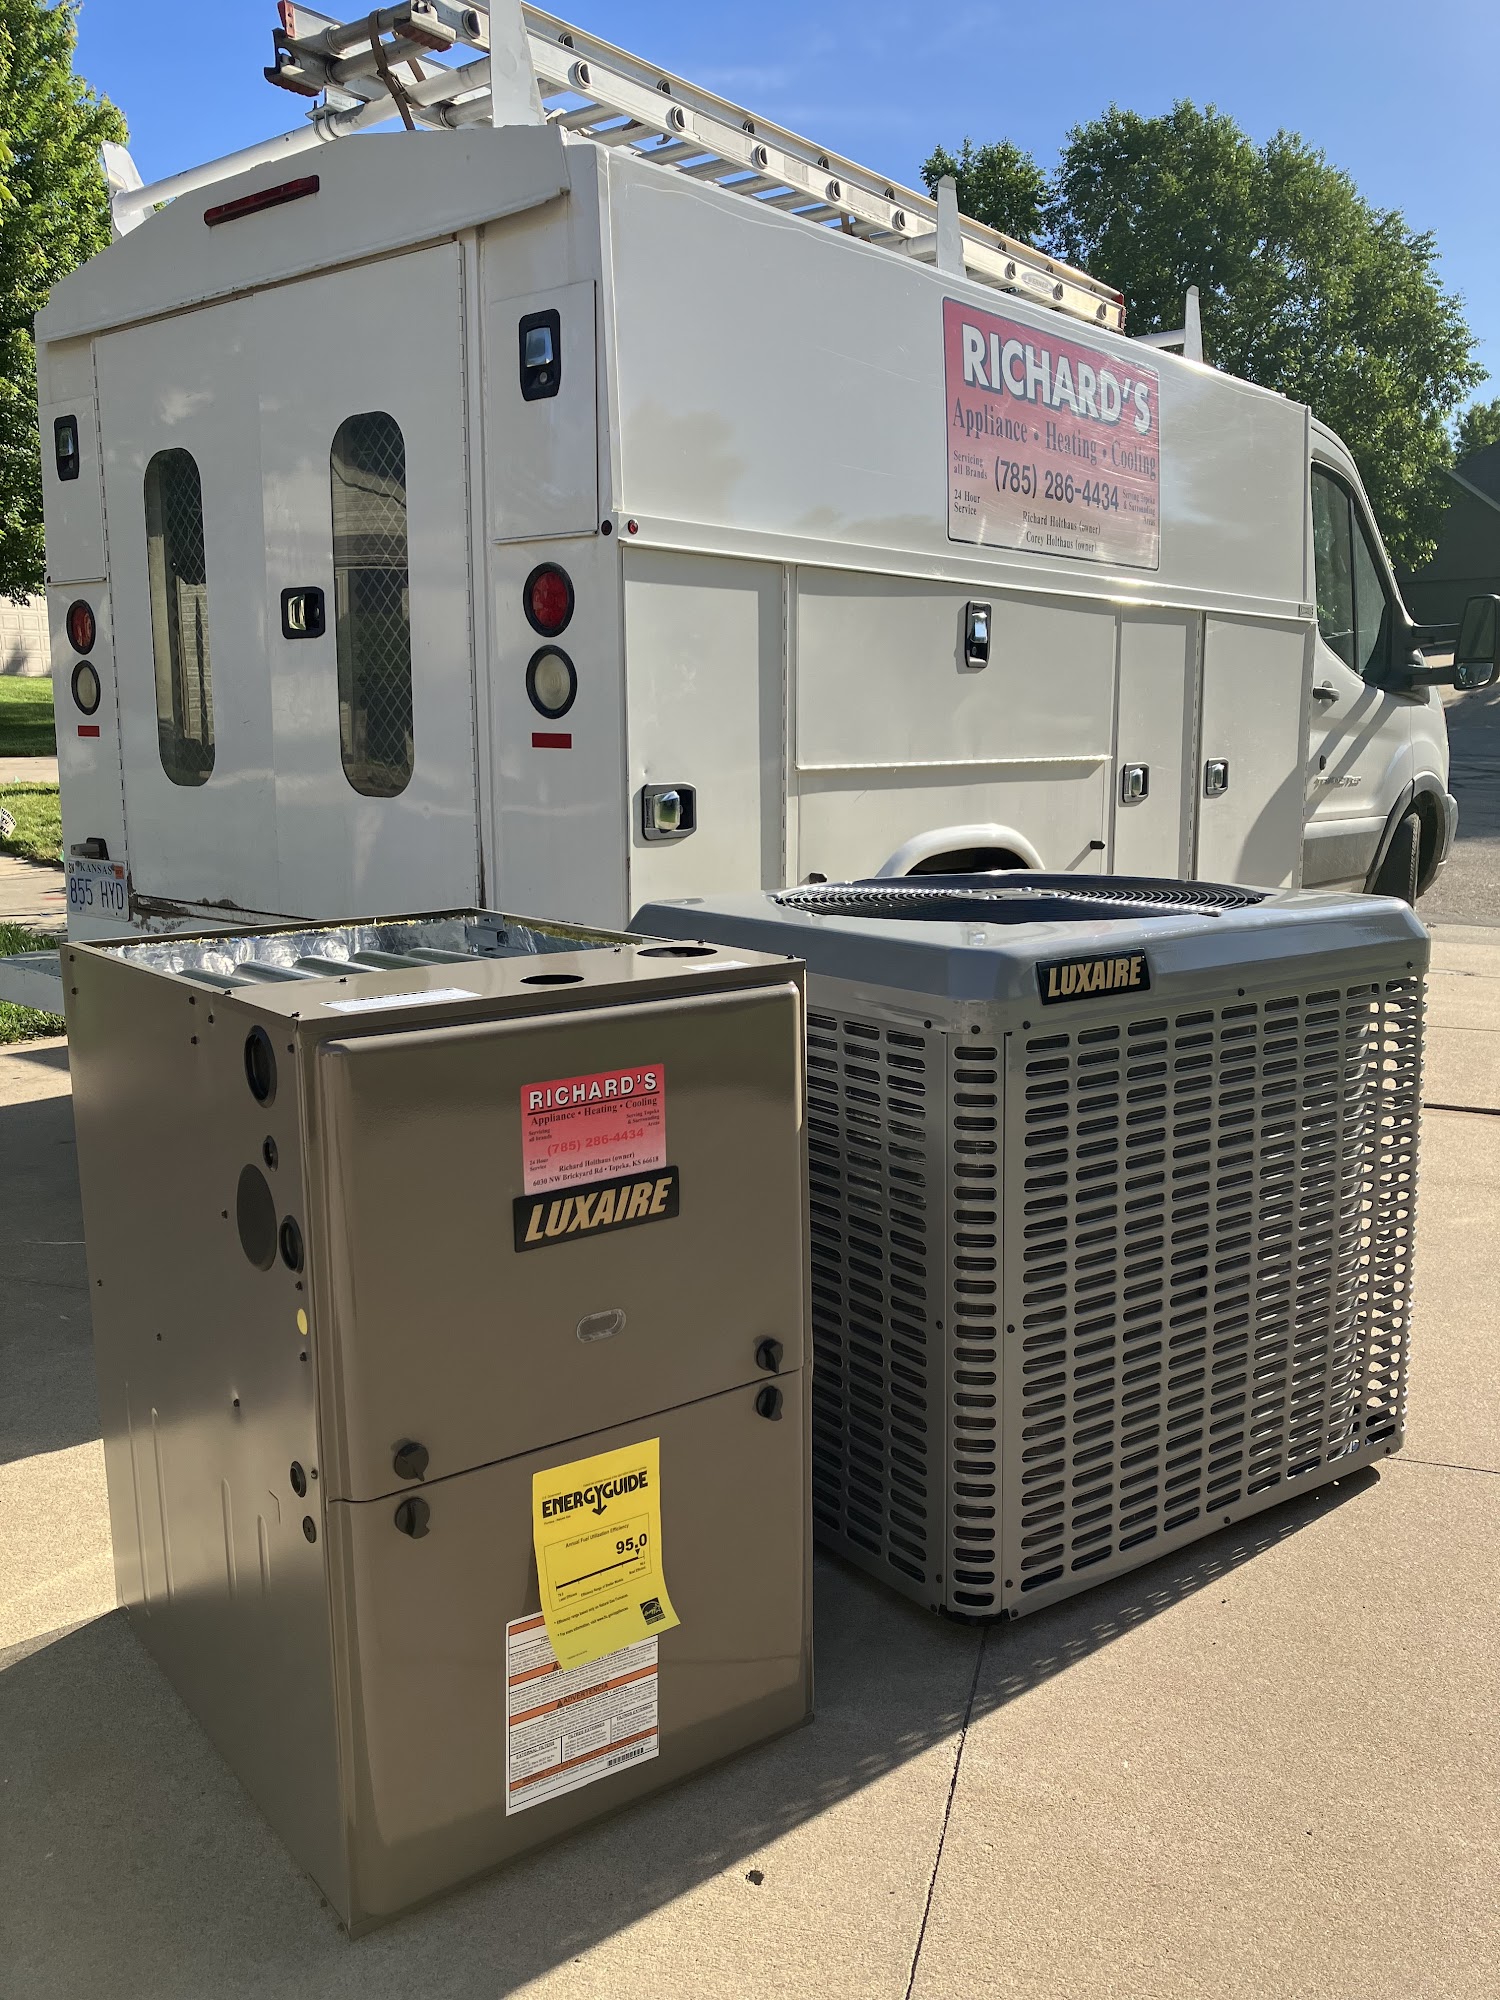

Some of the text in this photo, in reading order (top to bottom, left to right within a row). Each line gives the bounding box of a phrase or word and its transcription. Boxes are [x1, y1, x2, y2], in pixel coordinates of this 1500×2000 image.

[962, 322, 1152, 436] RICHARD'S
[953, 397, 1156, 480] Appliance Heating Cooling
[953, 450, 984, 468] Servicing
[954, 464, 987, 480] all Brands
[995, 456, 1119, 512] (785) 286-4434
[954, 489, 980, 504] 24 Hour
[954, 502, 977, 515] Service
[1022, 511, 1101, 536] Richard Holthaus (owner)
[1026, 530, 1097, 553] Corey Holthaus (owner)
[80, 862, 113, 876] KANSAS
[70, 877, 124, 910] 855 HYD
[1047, 956, 1143, 998] LUXAIRE
[529, 1072, 657, 1111] RICHARD'S
[531, 1097, 658, 1127] Appliance Heating Cooling
[626, 1111, 643, 1119] Serving
[528, 1127, 551, 1137] Servicing
[547, 1127, 644, 1157] (785) 286-4434
[532, 1177, 548, 1187] 6030
[549, 1175, 560, 1183] NW
[562, 1168, 593, 1180] Brickyard
[594, 1166, 603, 1175] Rd
[632, 1159, 641, 1167] KS
[559, 1152, 635, 1172] Richard Holthaus (owner)
[524, 1176, 673, 1243] LUXAIRE
[542, 1470, 648, 1519] ENERGYGUIDE
[565, 1539, 580, 1548] Annual
[590, 1530, 610, 1541] Utilization
[610, 1523, 630, 1534] Efficiency
[616, 1533, 648, 1555] 95.0
[563, 1682, 609, 1704] ADVERTENCIA
